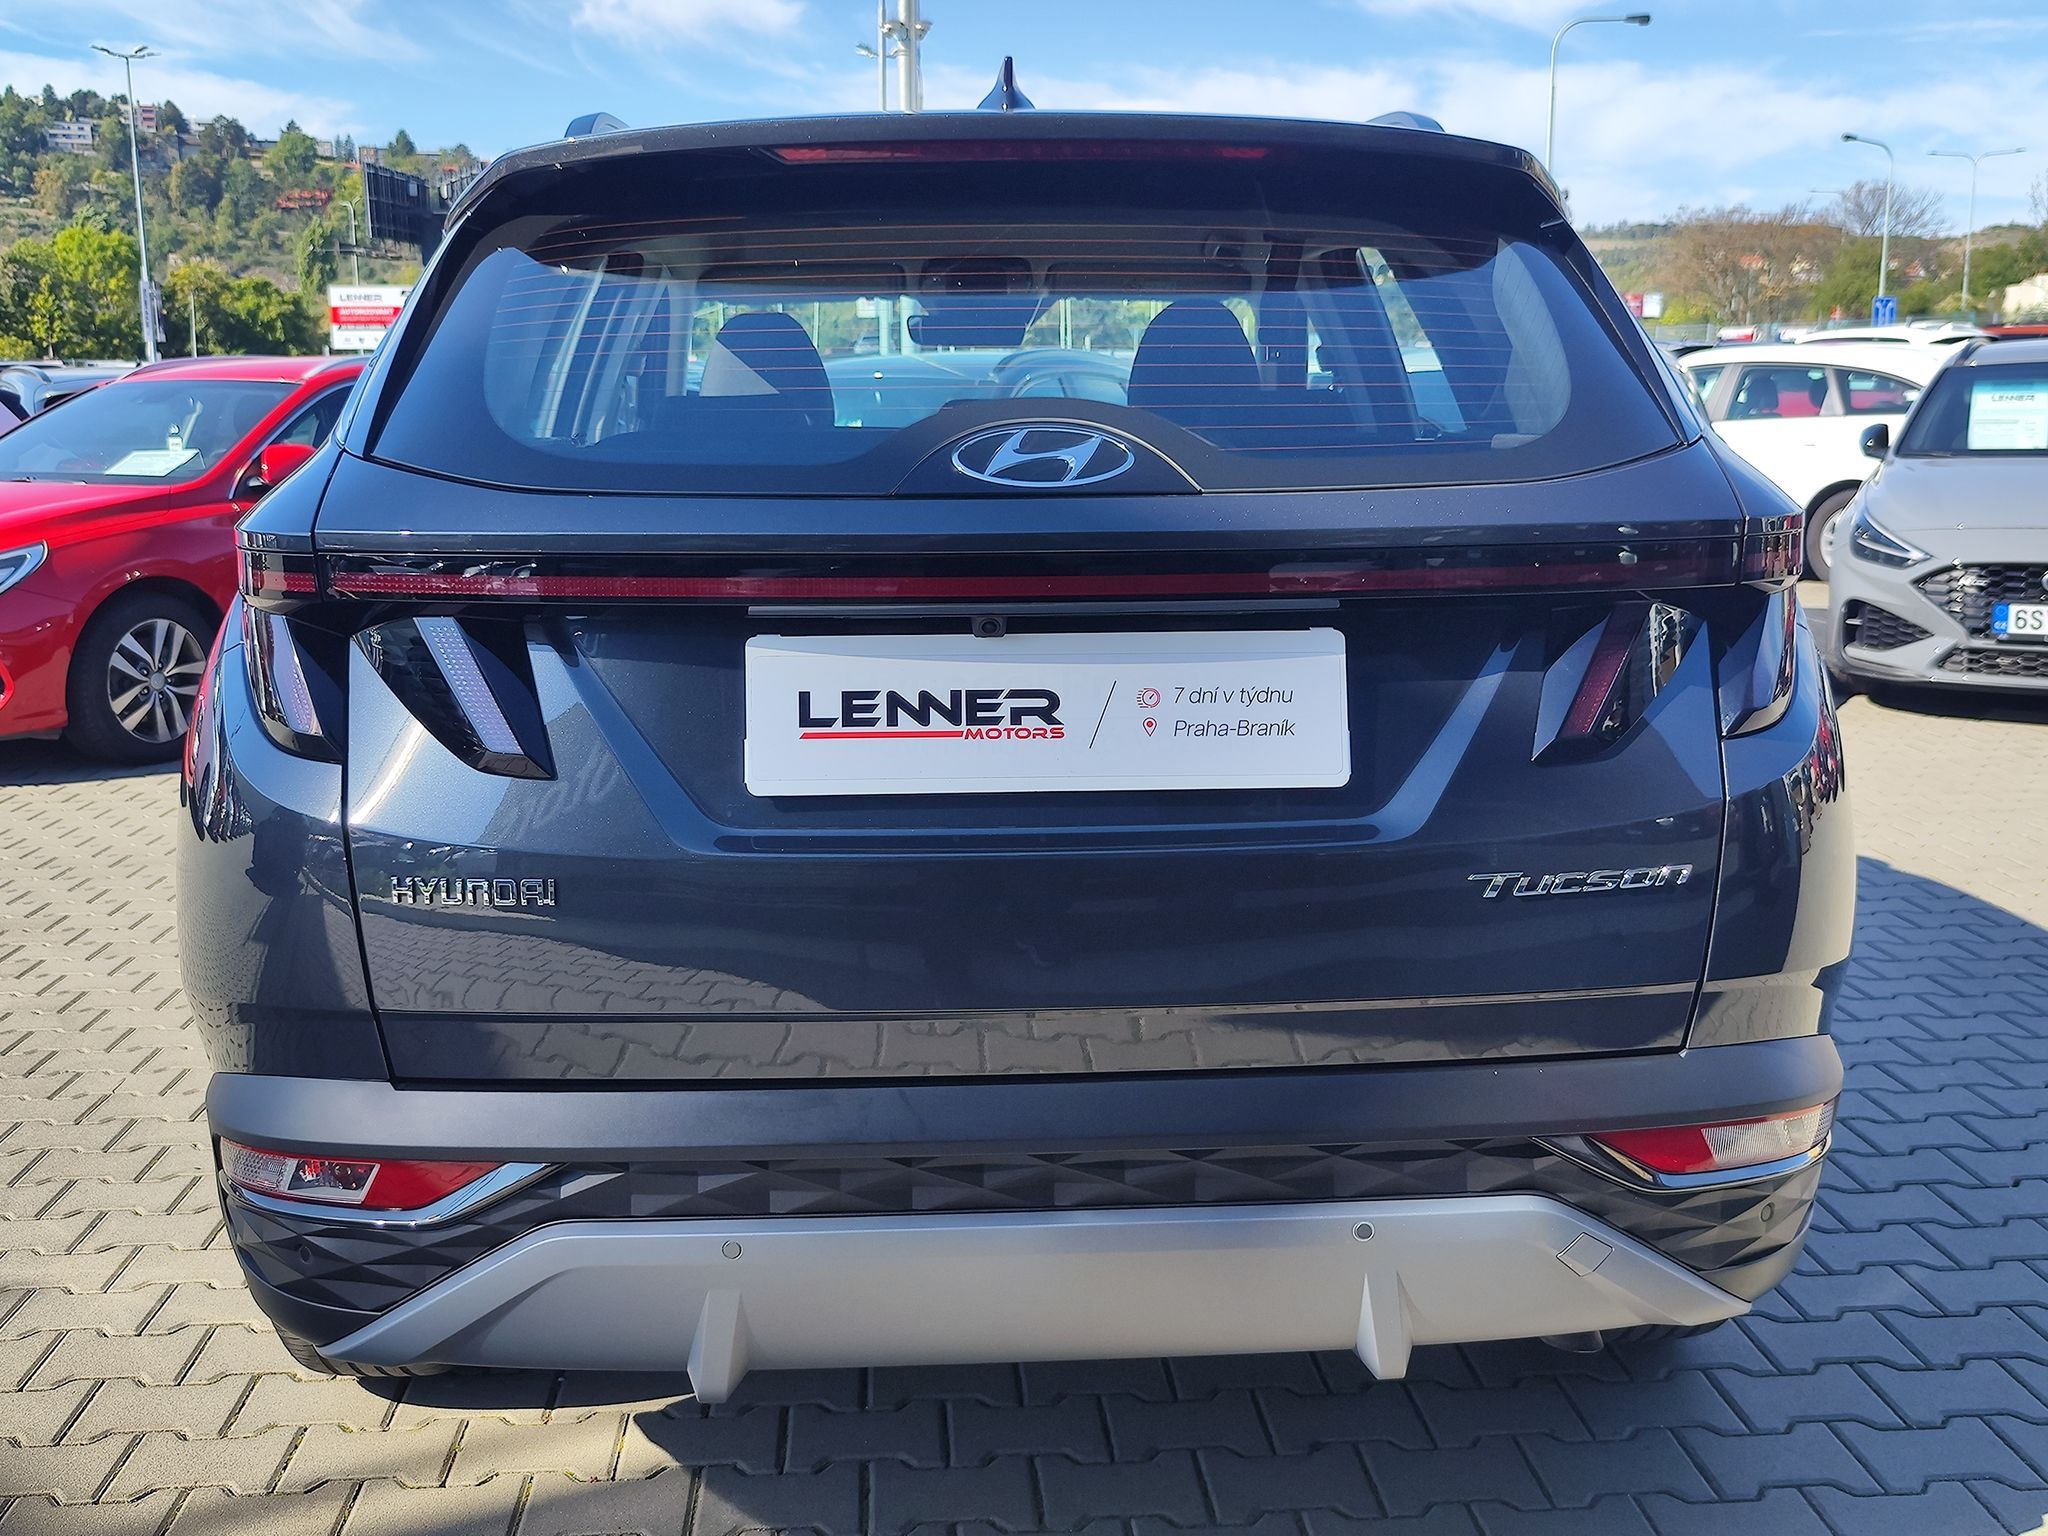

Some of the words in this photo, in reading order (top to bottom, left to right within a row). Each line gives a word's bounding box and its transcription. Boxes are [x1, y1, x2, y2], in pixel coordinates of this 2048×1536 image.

[2015, 609, 2048, 630] 6S
[1173, 686, 1185, 704] 7
[1188, 686, 1219, 704] dní
[1223, 690, 1235, 704] v
[1239, 686, 1294, 708] týdnu
[798, 689, 1065, 728] LENNER
[964, 727, 1065, 740] MOTORS
[1173, 718, 1296, 737] Praha-Braník
[390, 876, 556, 906] HYUNDAI
[1467, 863, 1694, 899] TUCSON
